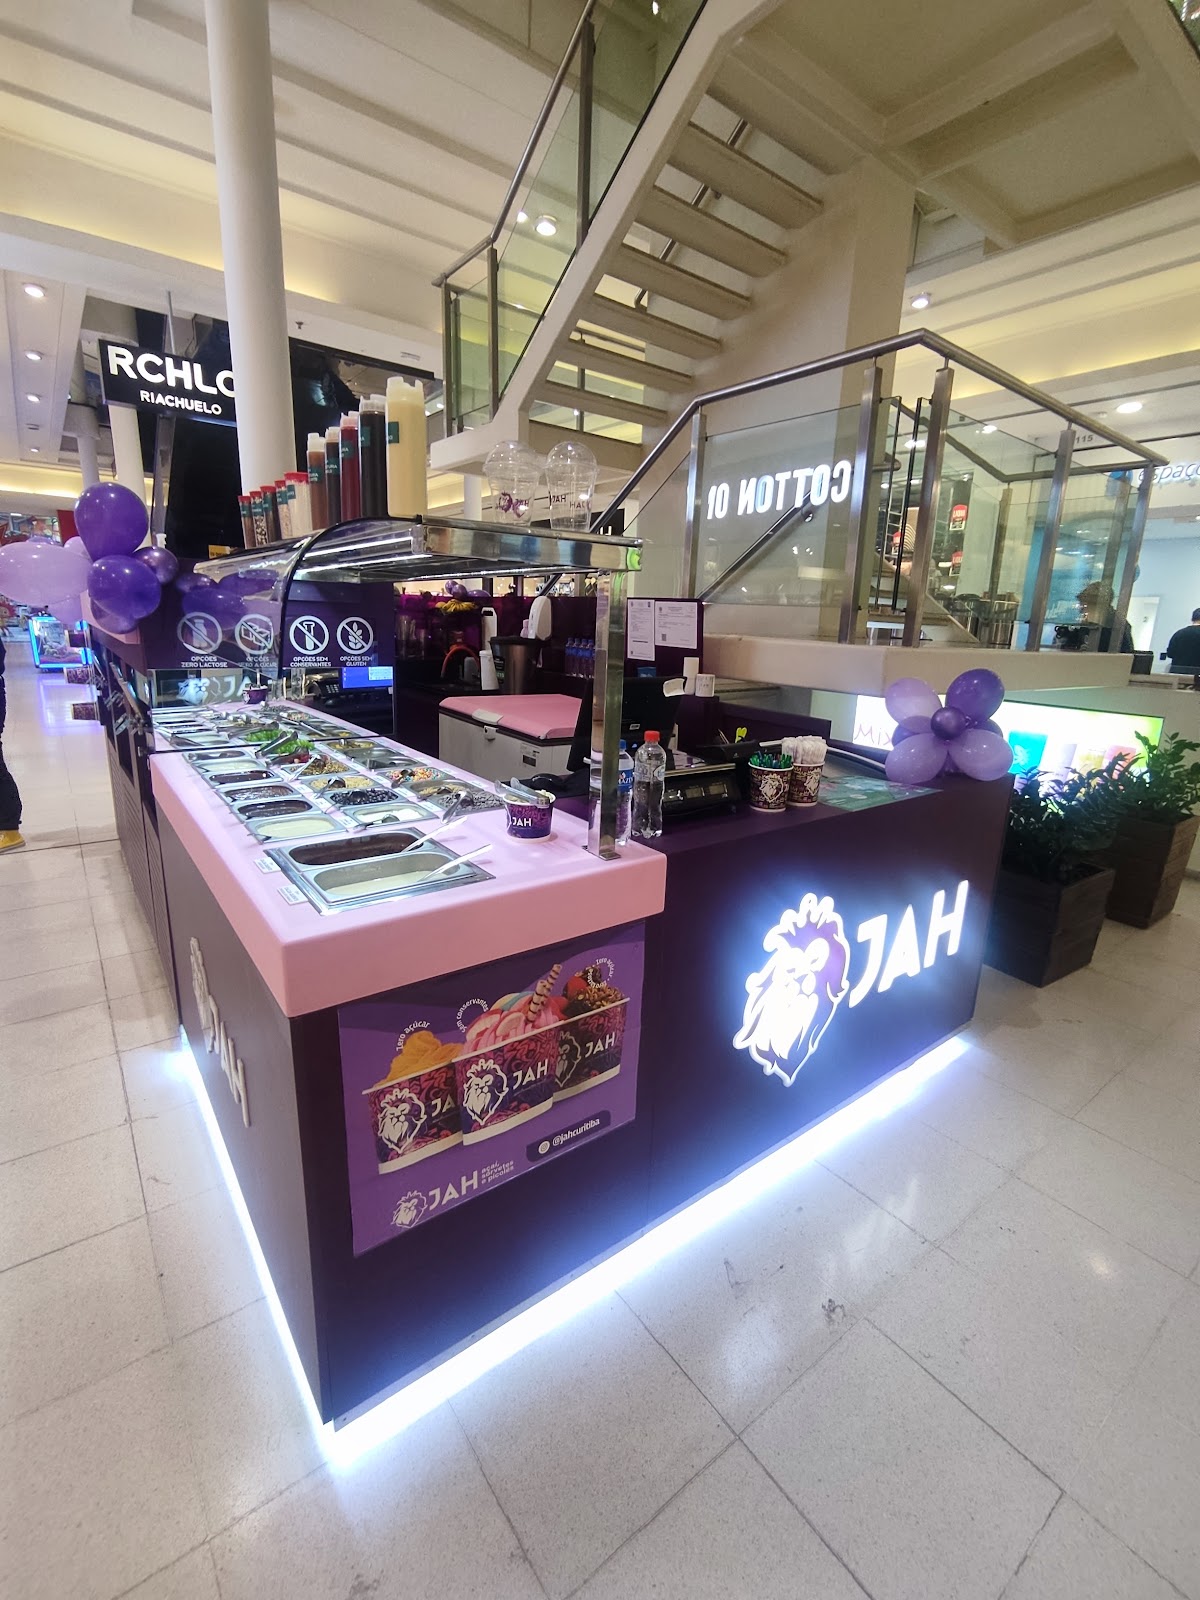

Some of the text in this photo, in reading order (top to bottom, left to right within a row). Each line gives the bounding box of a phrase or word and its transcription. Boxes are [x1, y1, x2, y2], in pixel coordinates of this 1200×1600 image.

[140, 389, 222, 415] RIACHUELO
[512, 817, 532, 827] JAH
[849, 879, 969, 1009] JAH
[456, 998, 489, 1020] conservantes
[403, 1020, 431, 1034] açúcar
[585, 1031, 616, 1058] JAH
[512, 1058, 549, 1090] JAH
[431, 1094, 456, 1117] JA
[552, 1118, 600, 1147] @jahcuritiba
[428, 1170, 478, 1211] JAH
